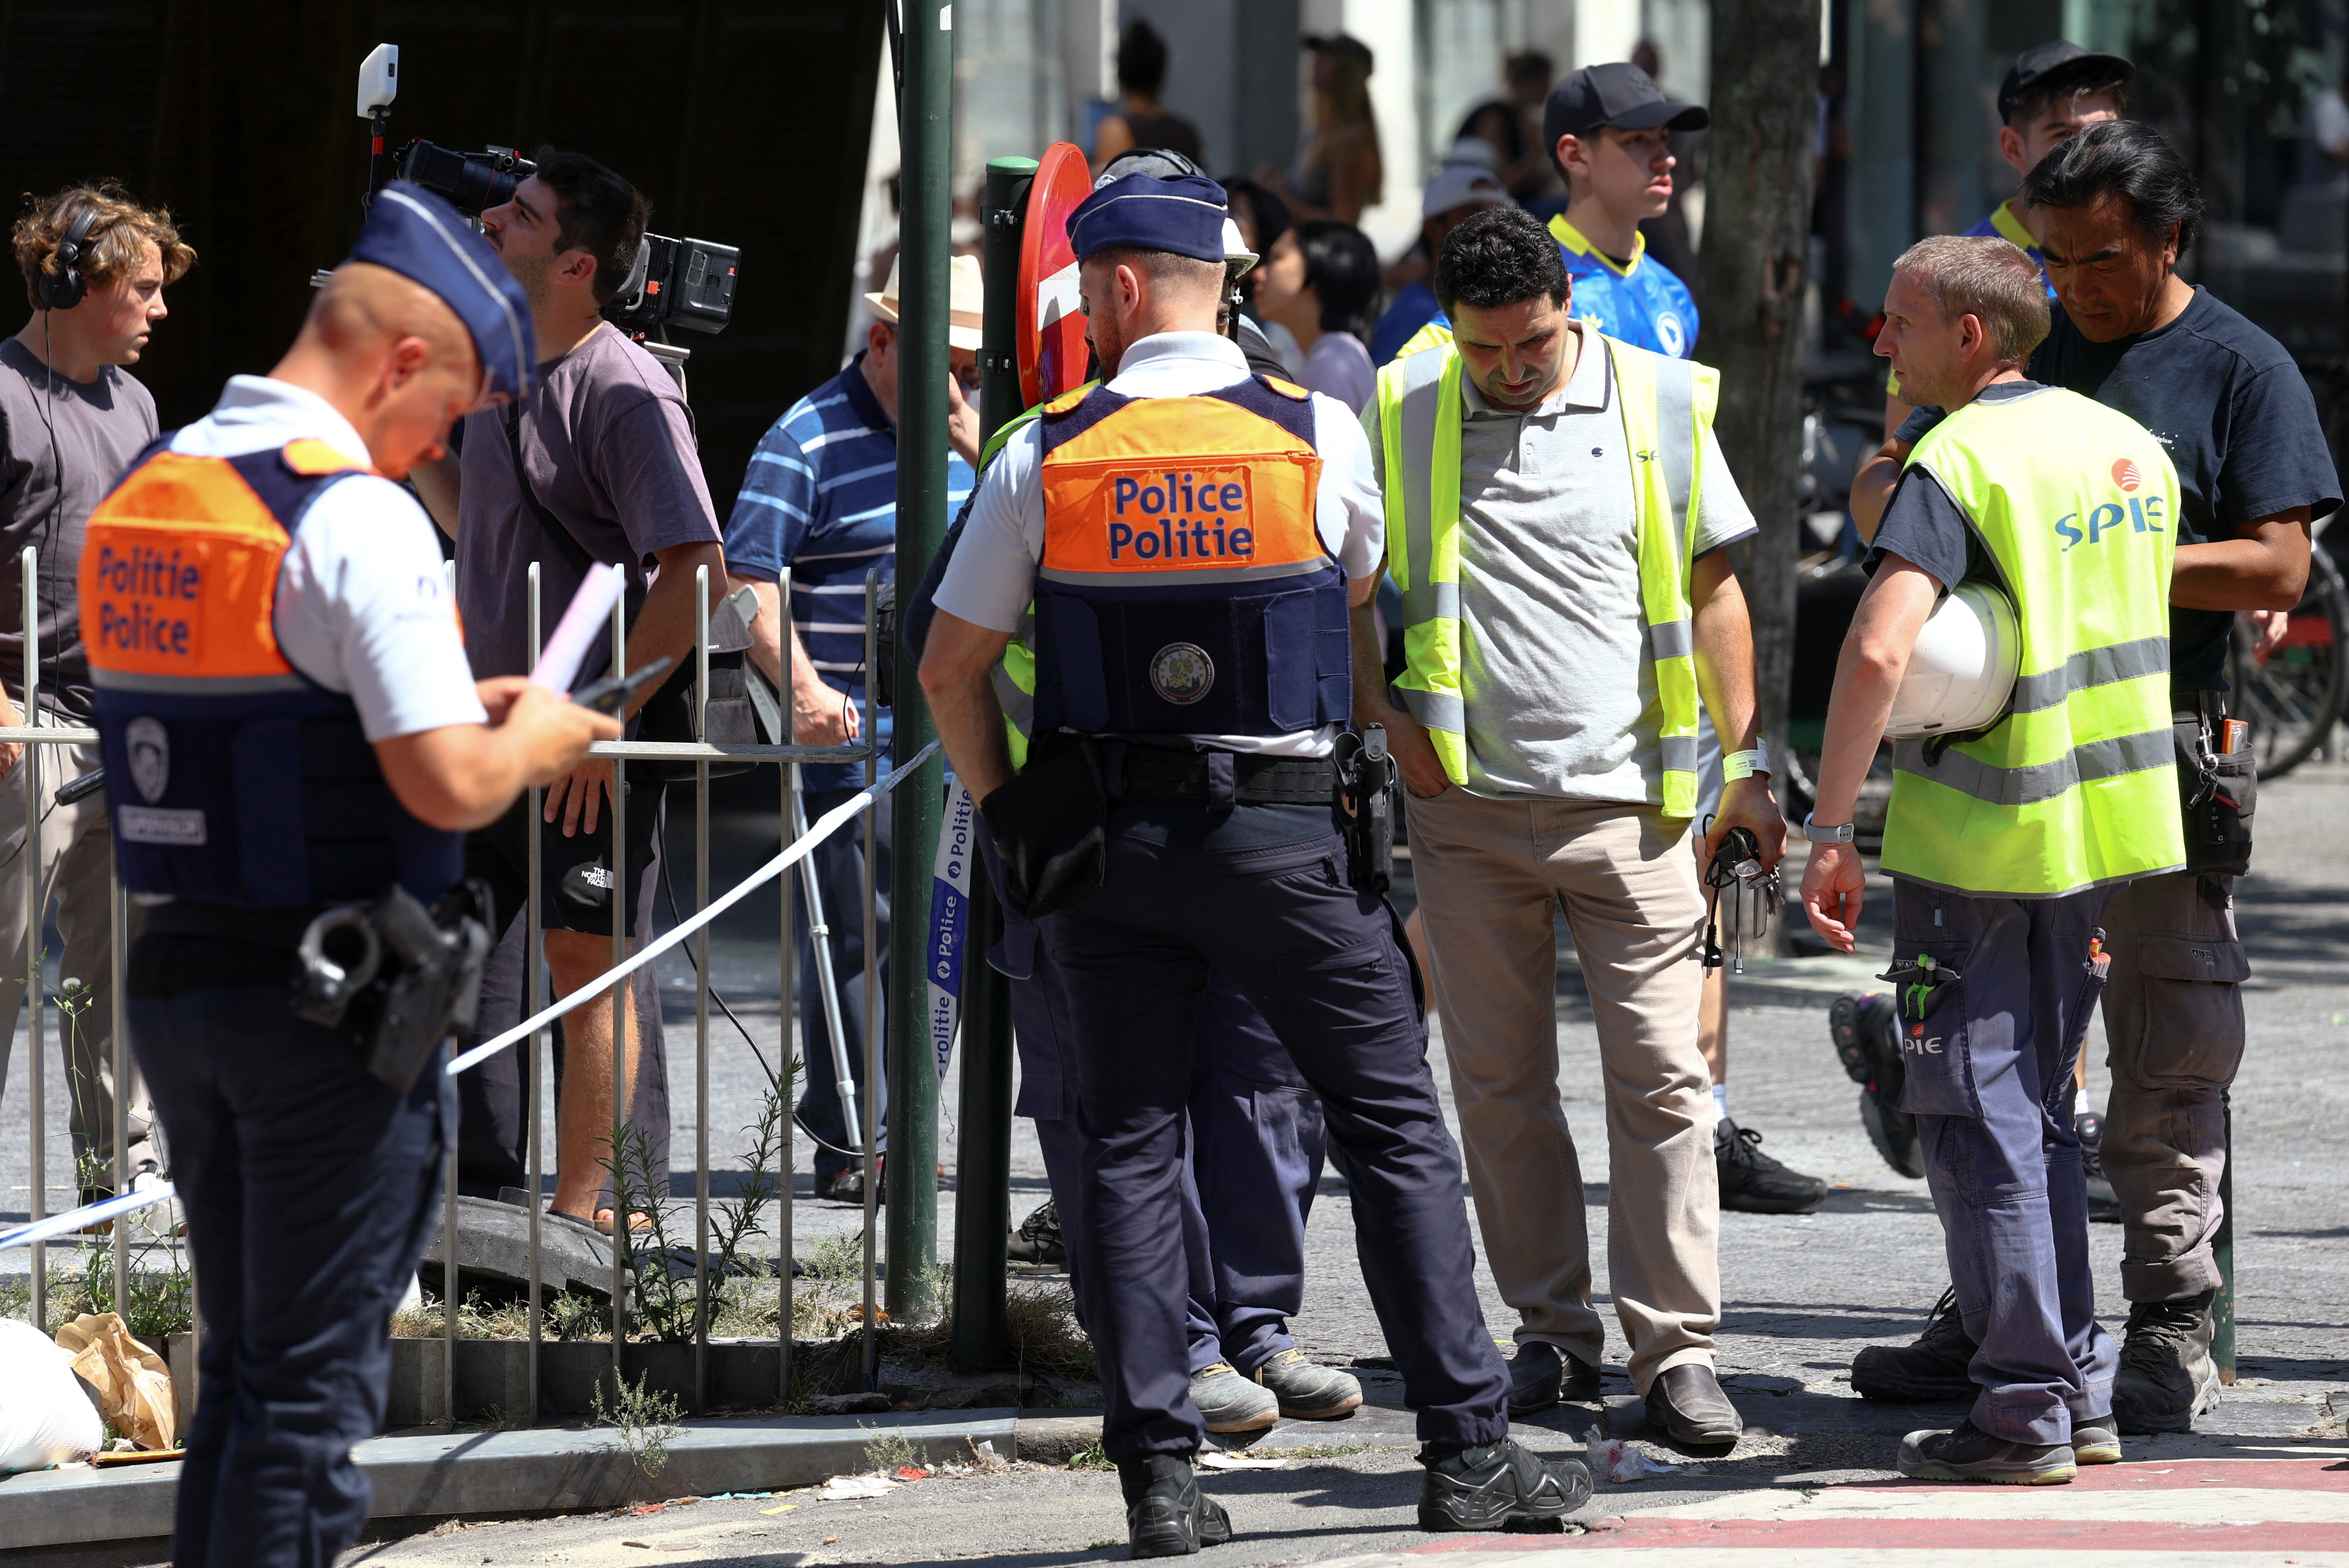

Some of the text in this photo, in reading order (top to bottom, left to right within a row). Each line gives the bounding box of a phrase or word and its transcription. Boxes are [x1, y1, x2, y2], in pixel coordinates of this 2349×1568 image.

[1115, 473, 1243, 516] Police
[1109, 517, 1252, 560] Politie
[2055, 496, 2164, 552] SPIE
[98, 546, 198, 598] Politie
[100, 603, 188, 654] Police
[950, 789, 971, 856] Politie
[581, 871, 605, 881] NORTH
[587, 878, 605, 887] FACE
[594, 867, 607, 875] THE
[938, 896, 957, 956] Police
[1904, 1037, 1943, 1055] PIE
